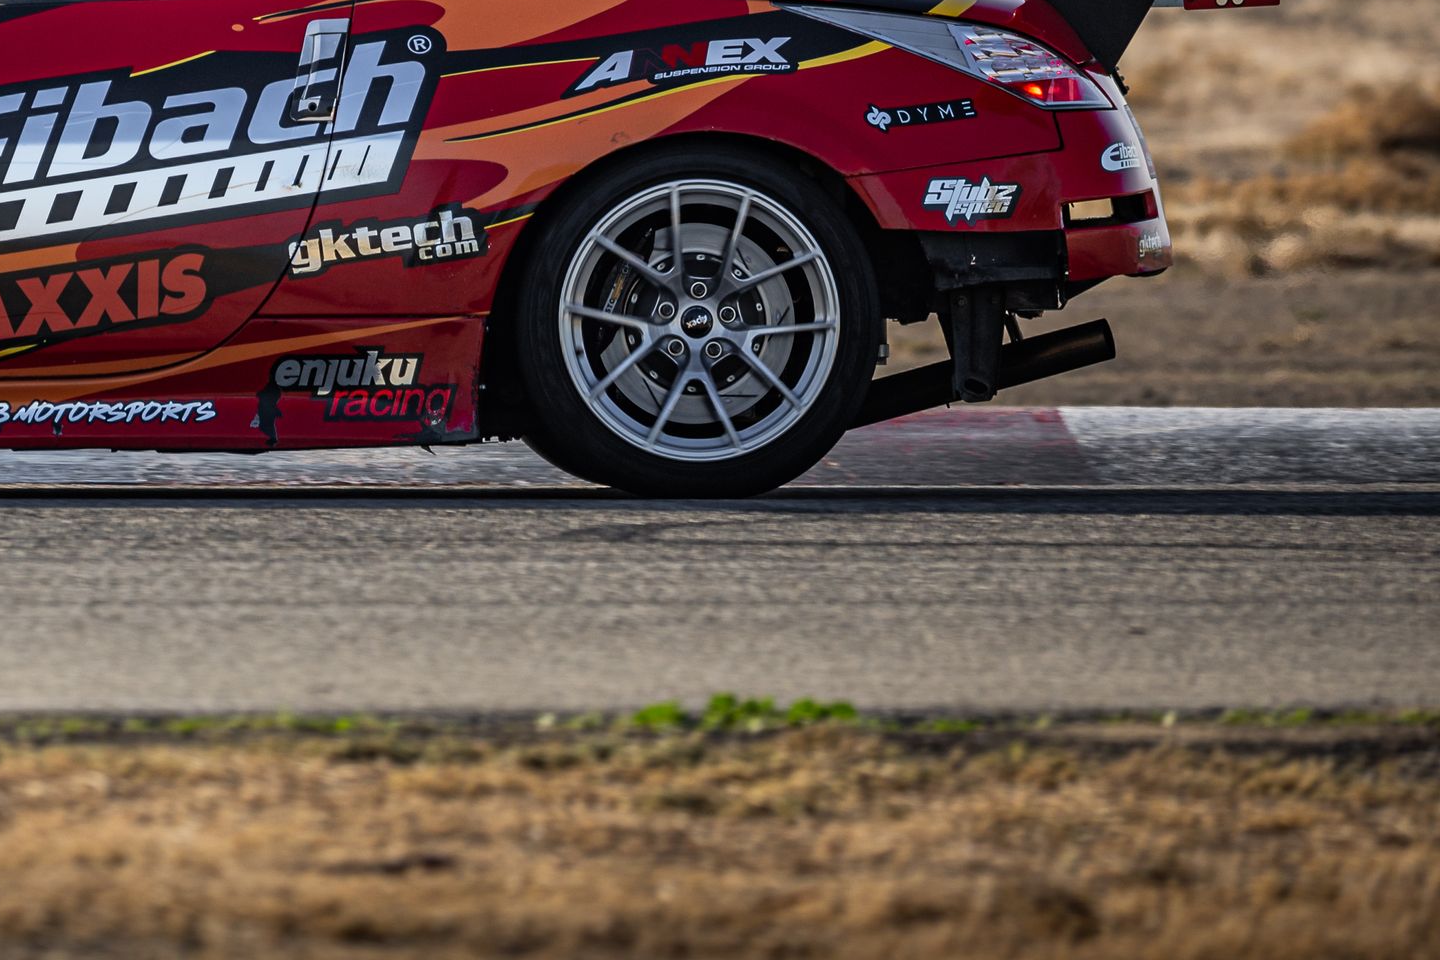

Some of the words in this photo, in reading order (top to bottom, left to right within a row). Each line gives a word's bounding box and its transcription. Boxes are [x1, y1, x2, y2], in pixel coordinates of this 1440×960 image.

[654, 65, 741, 80] SUSPENSION
[743, 63, 791, 72] GROUP
[288, 210, 476, 275] gktech
[418, 239, 480, 261] com
[274, 350, 418, 396] enjuku
[13, 401, 217, 424] MOTORSPORTS
[329, 388, 452, 426] racing
